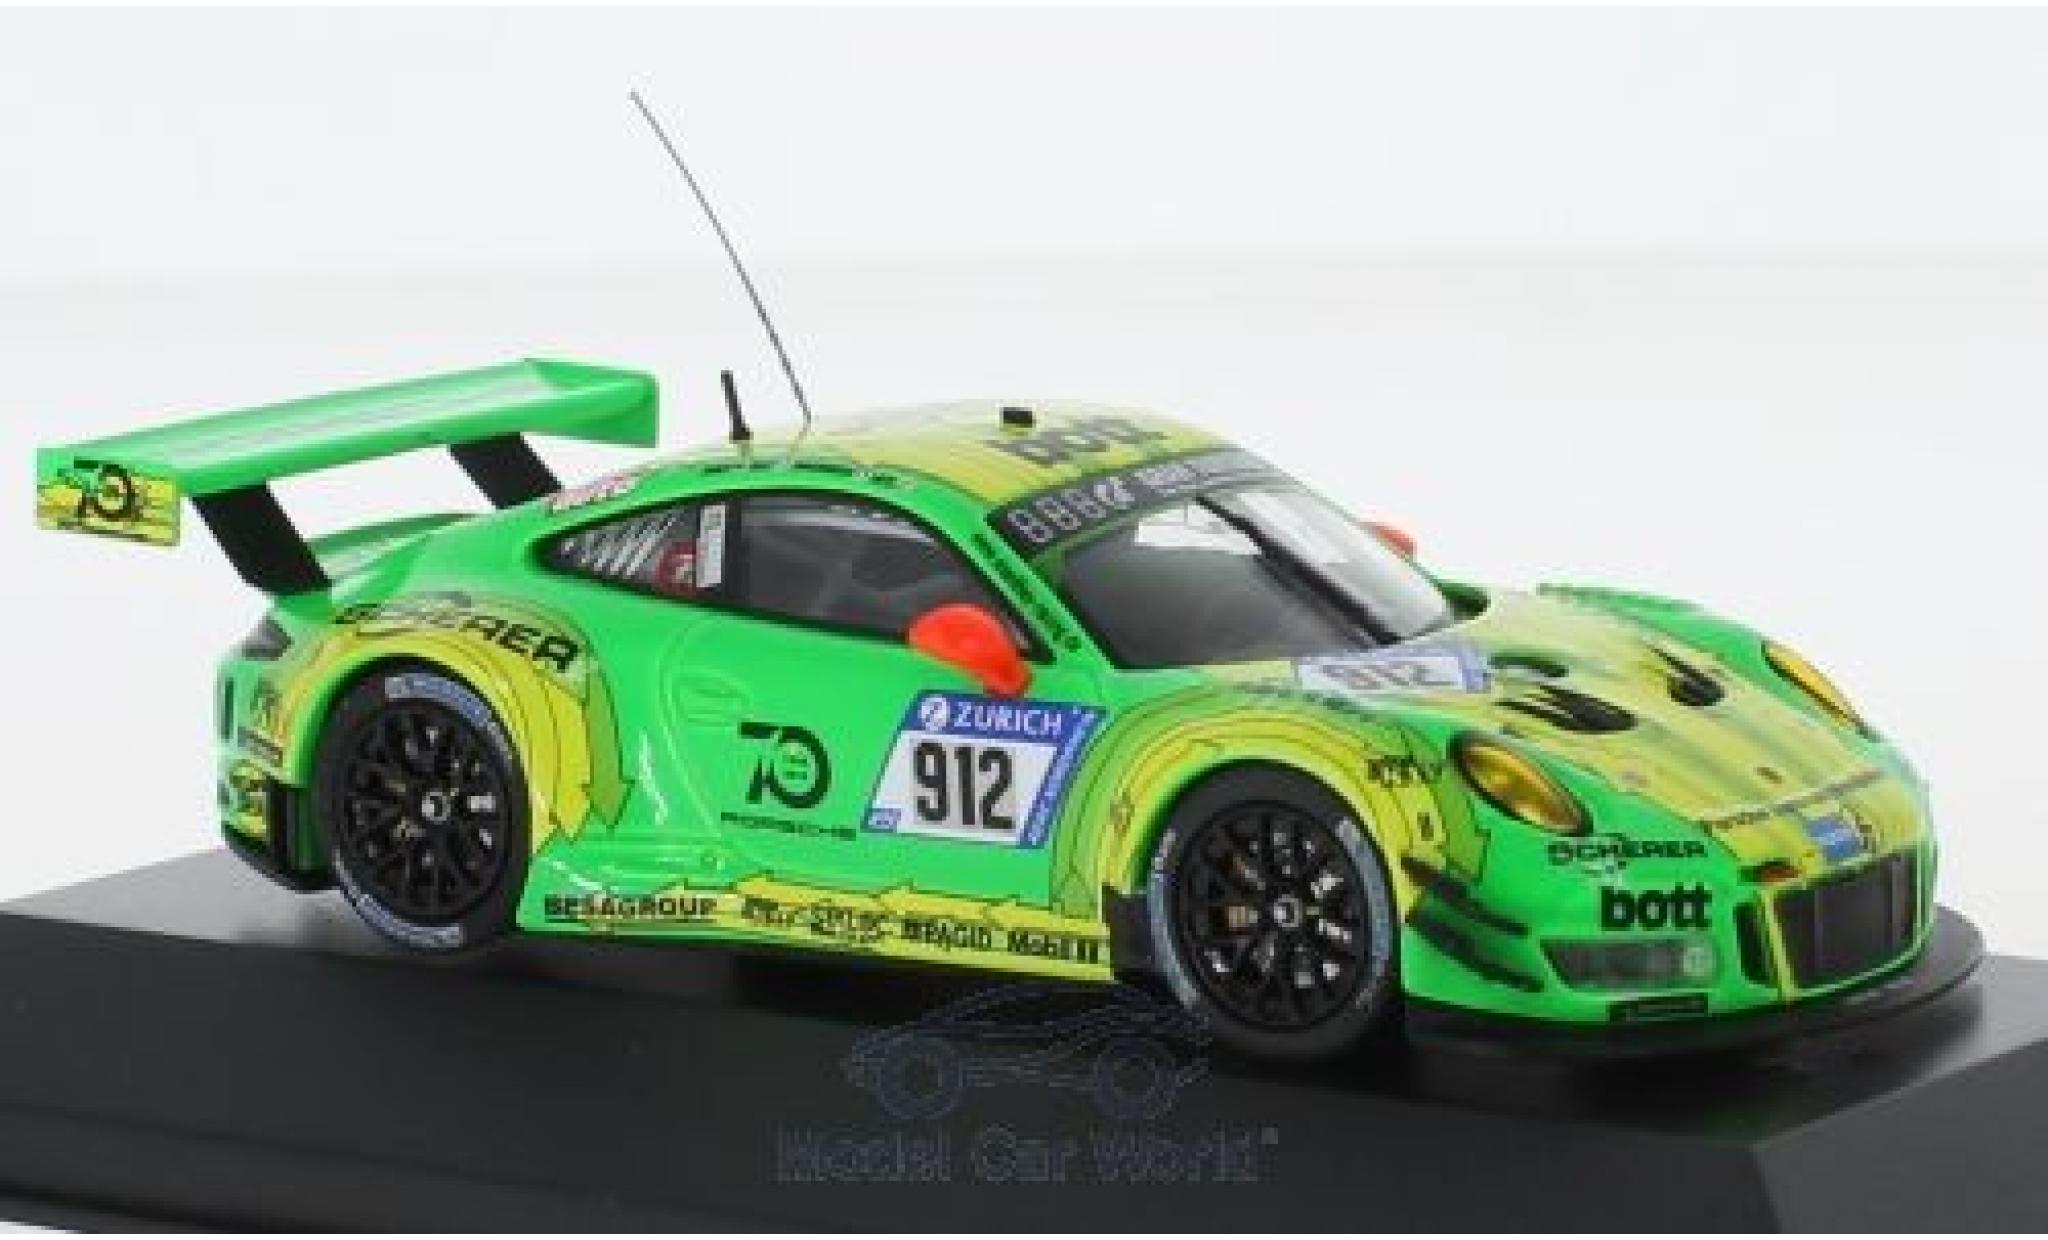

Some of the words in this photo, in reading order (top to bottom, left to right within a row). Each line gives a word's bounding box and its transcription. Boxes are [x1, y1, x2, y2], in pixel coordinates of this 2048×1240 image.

[954, 701, 1062, 736] ZURICH
[740, 722, 831, 808] 70
[914, 741, 1014, 830] 912
[1600, 881, 1713, 931] bott
